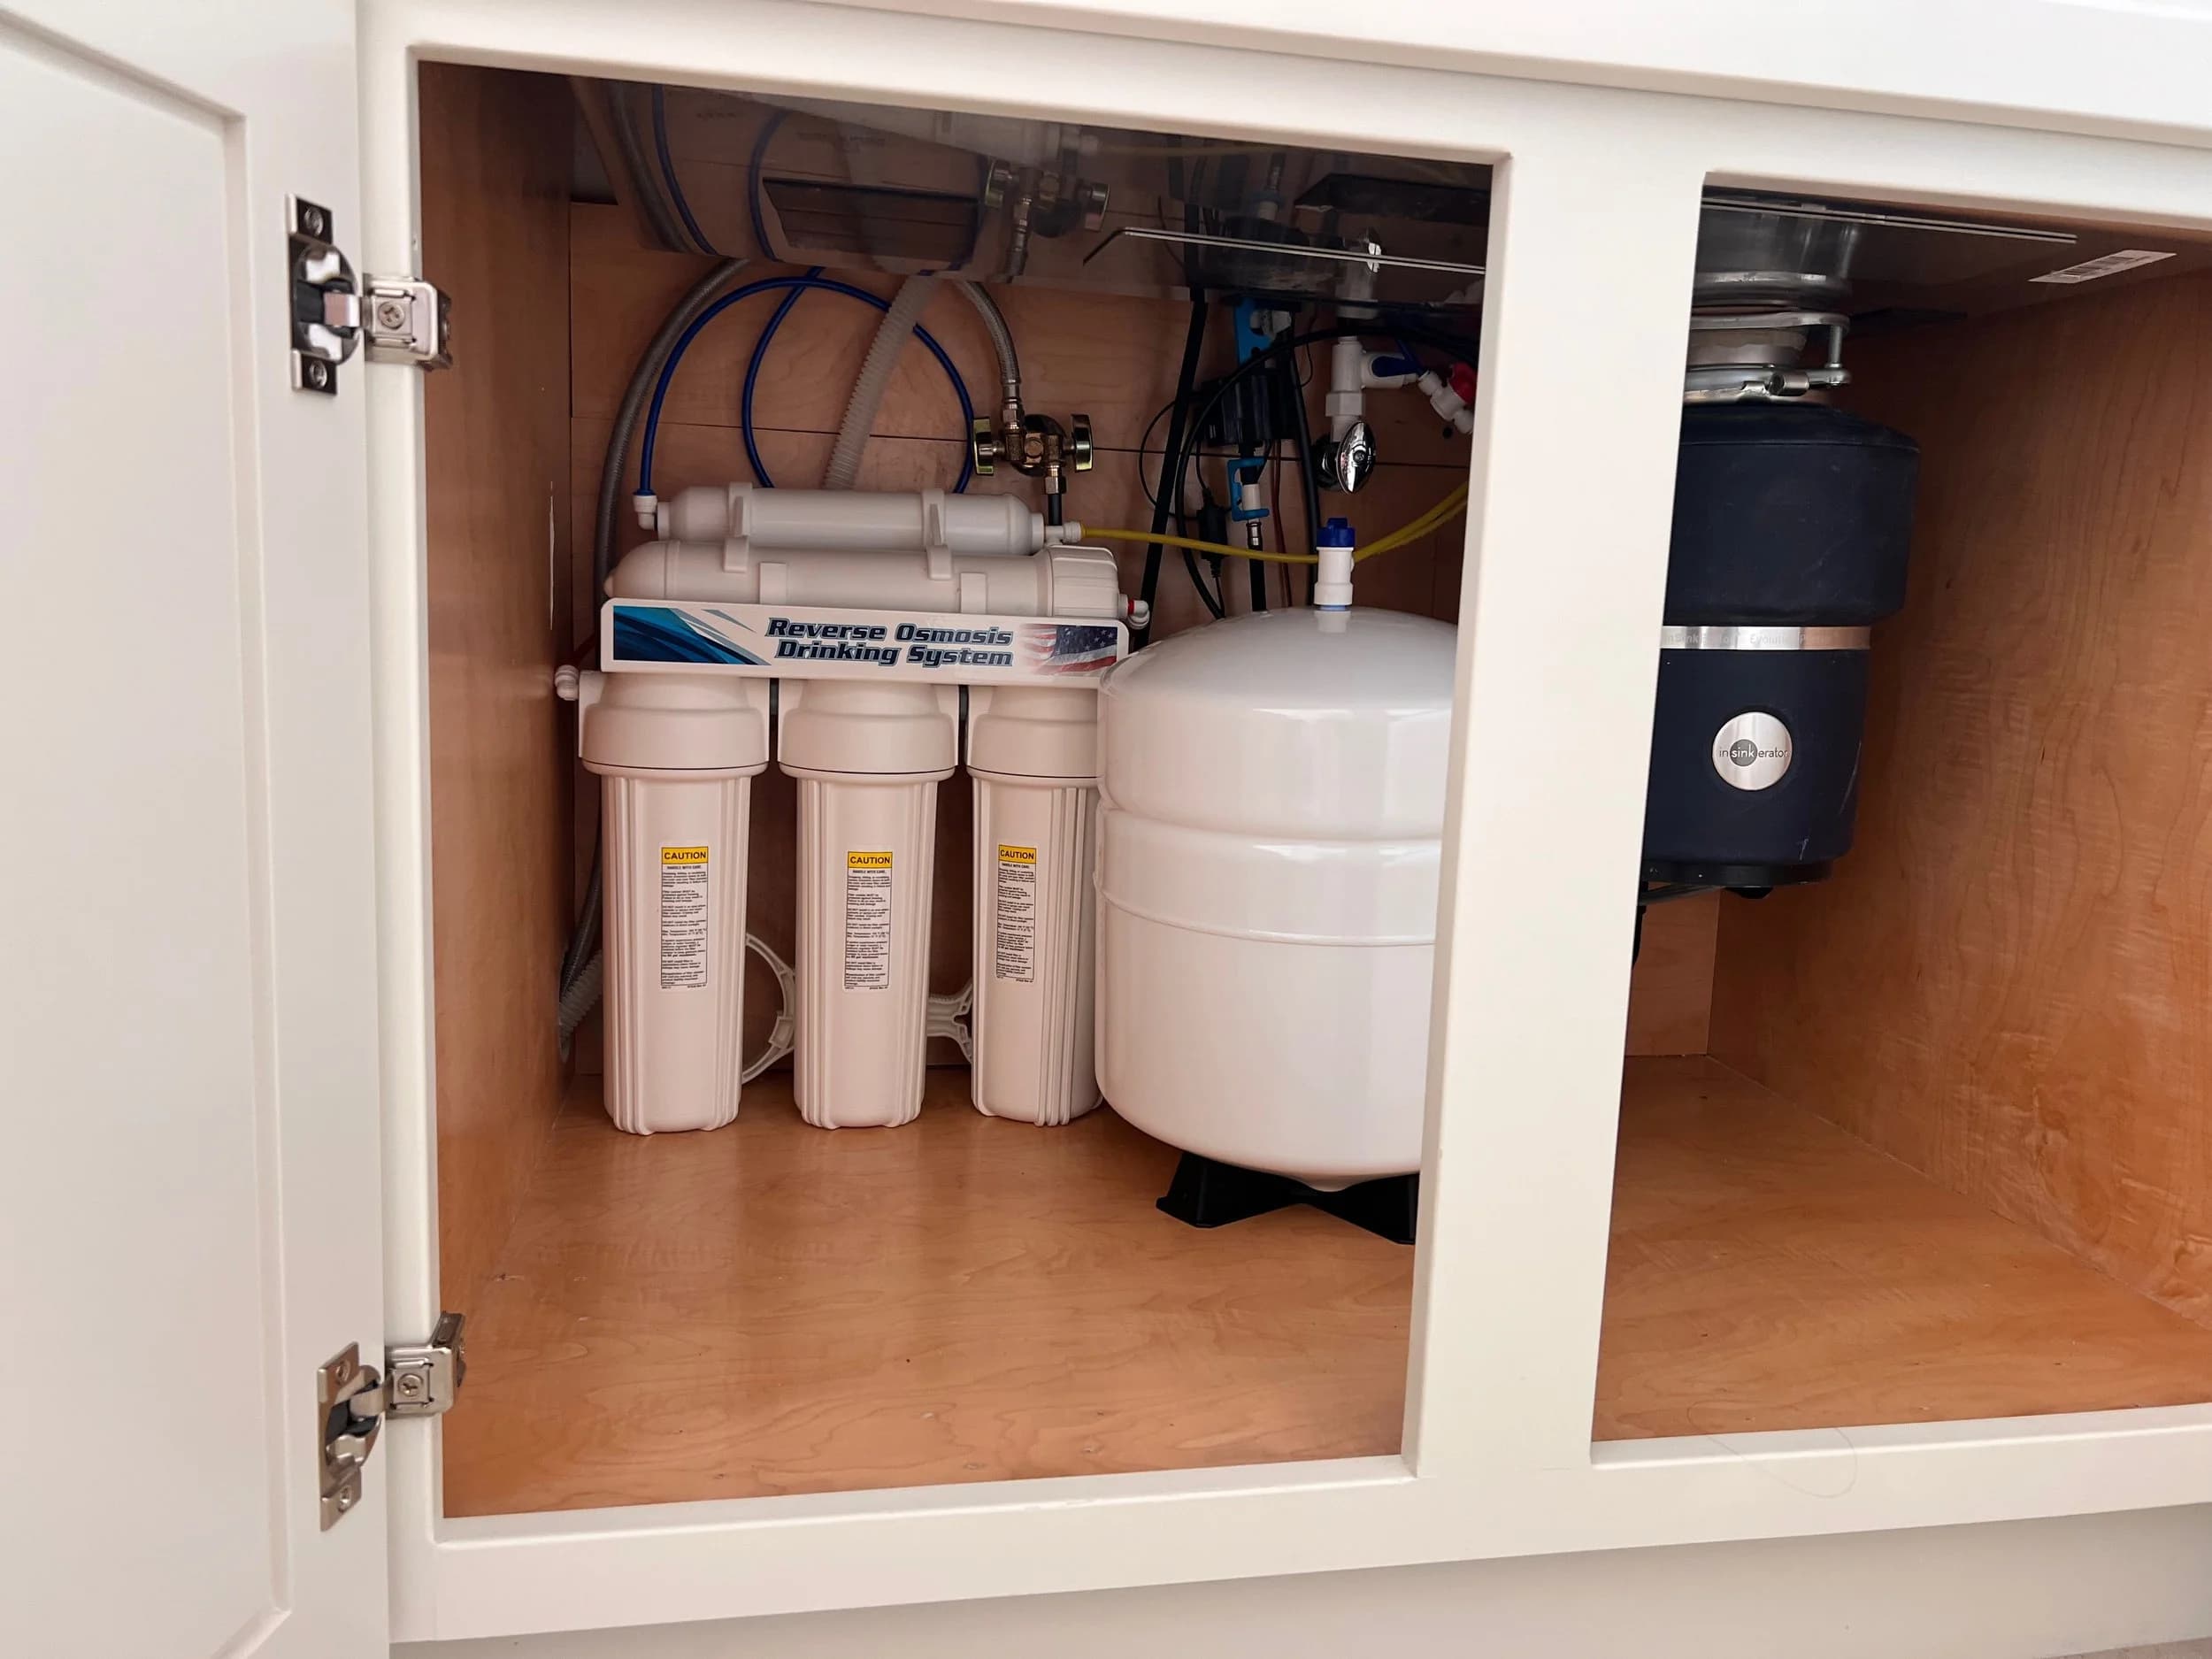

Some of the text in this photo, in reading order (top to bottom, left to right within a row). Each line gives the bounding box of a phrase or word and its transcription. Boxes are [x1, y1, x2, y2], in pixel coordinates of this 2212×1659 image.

[765, 618, 1013, 646] Reverse Osmosis
[775, 639, 1013, 668] Drinking System
[664, 851, 707, 860] CAUTION
[849, 856, 891, 864] CAUTION
[1000, 849, 1034, 860] CAUTION
